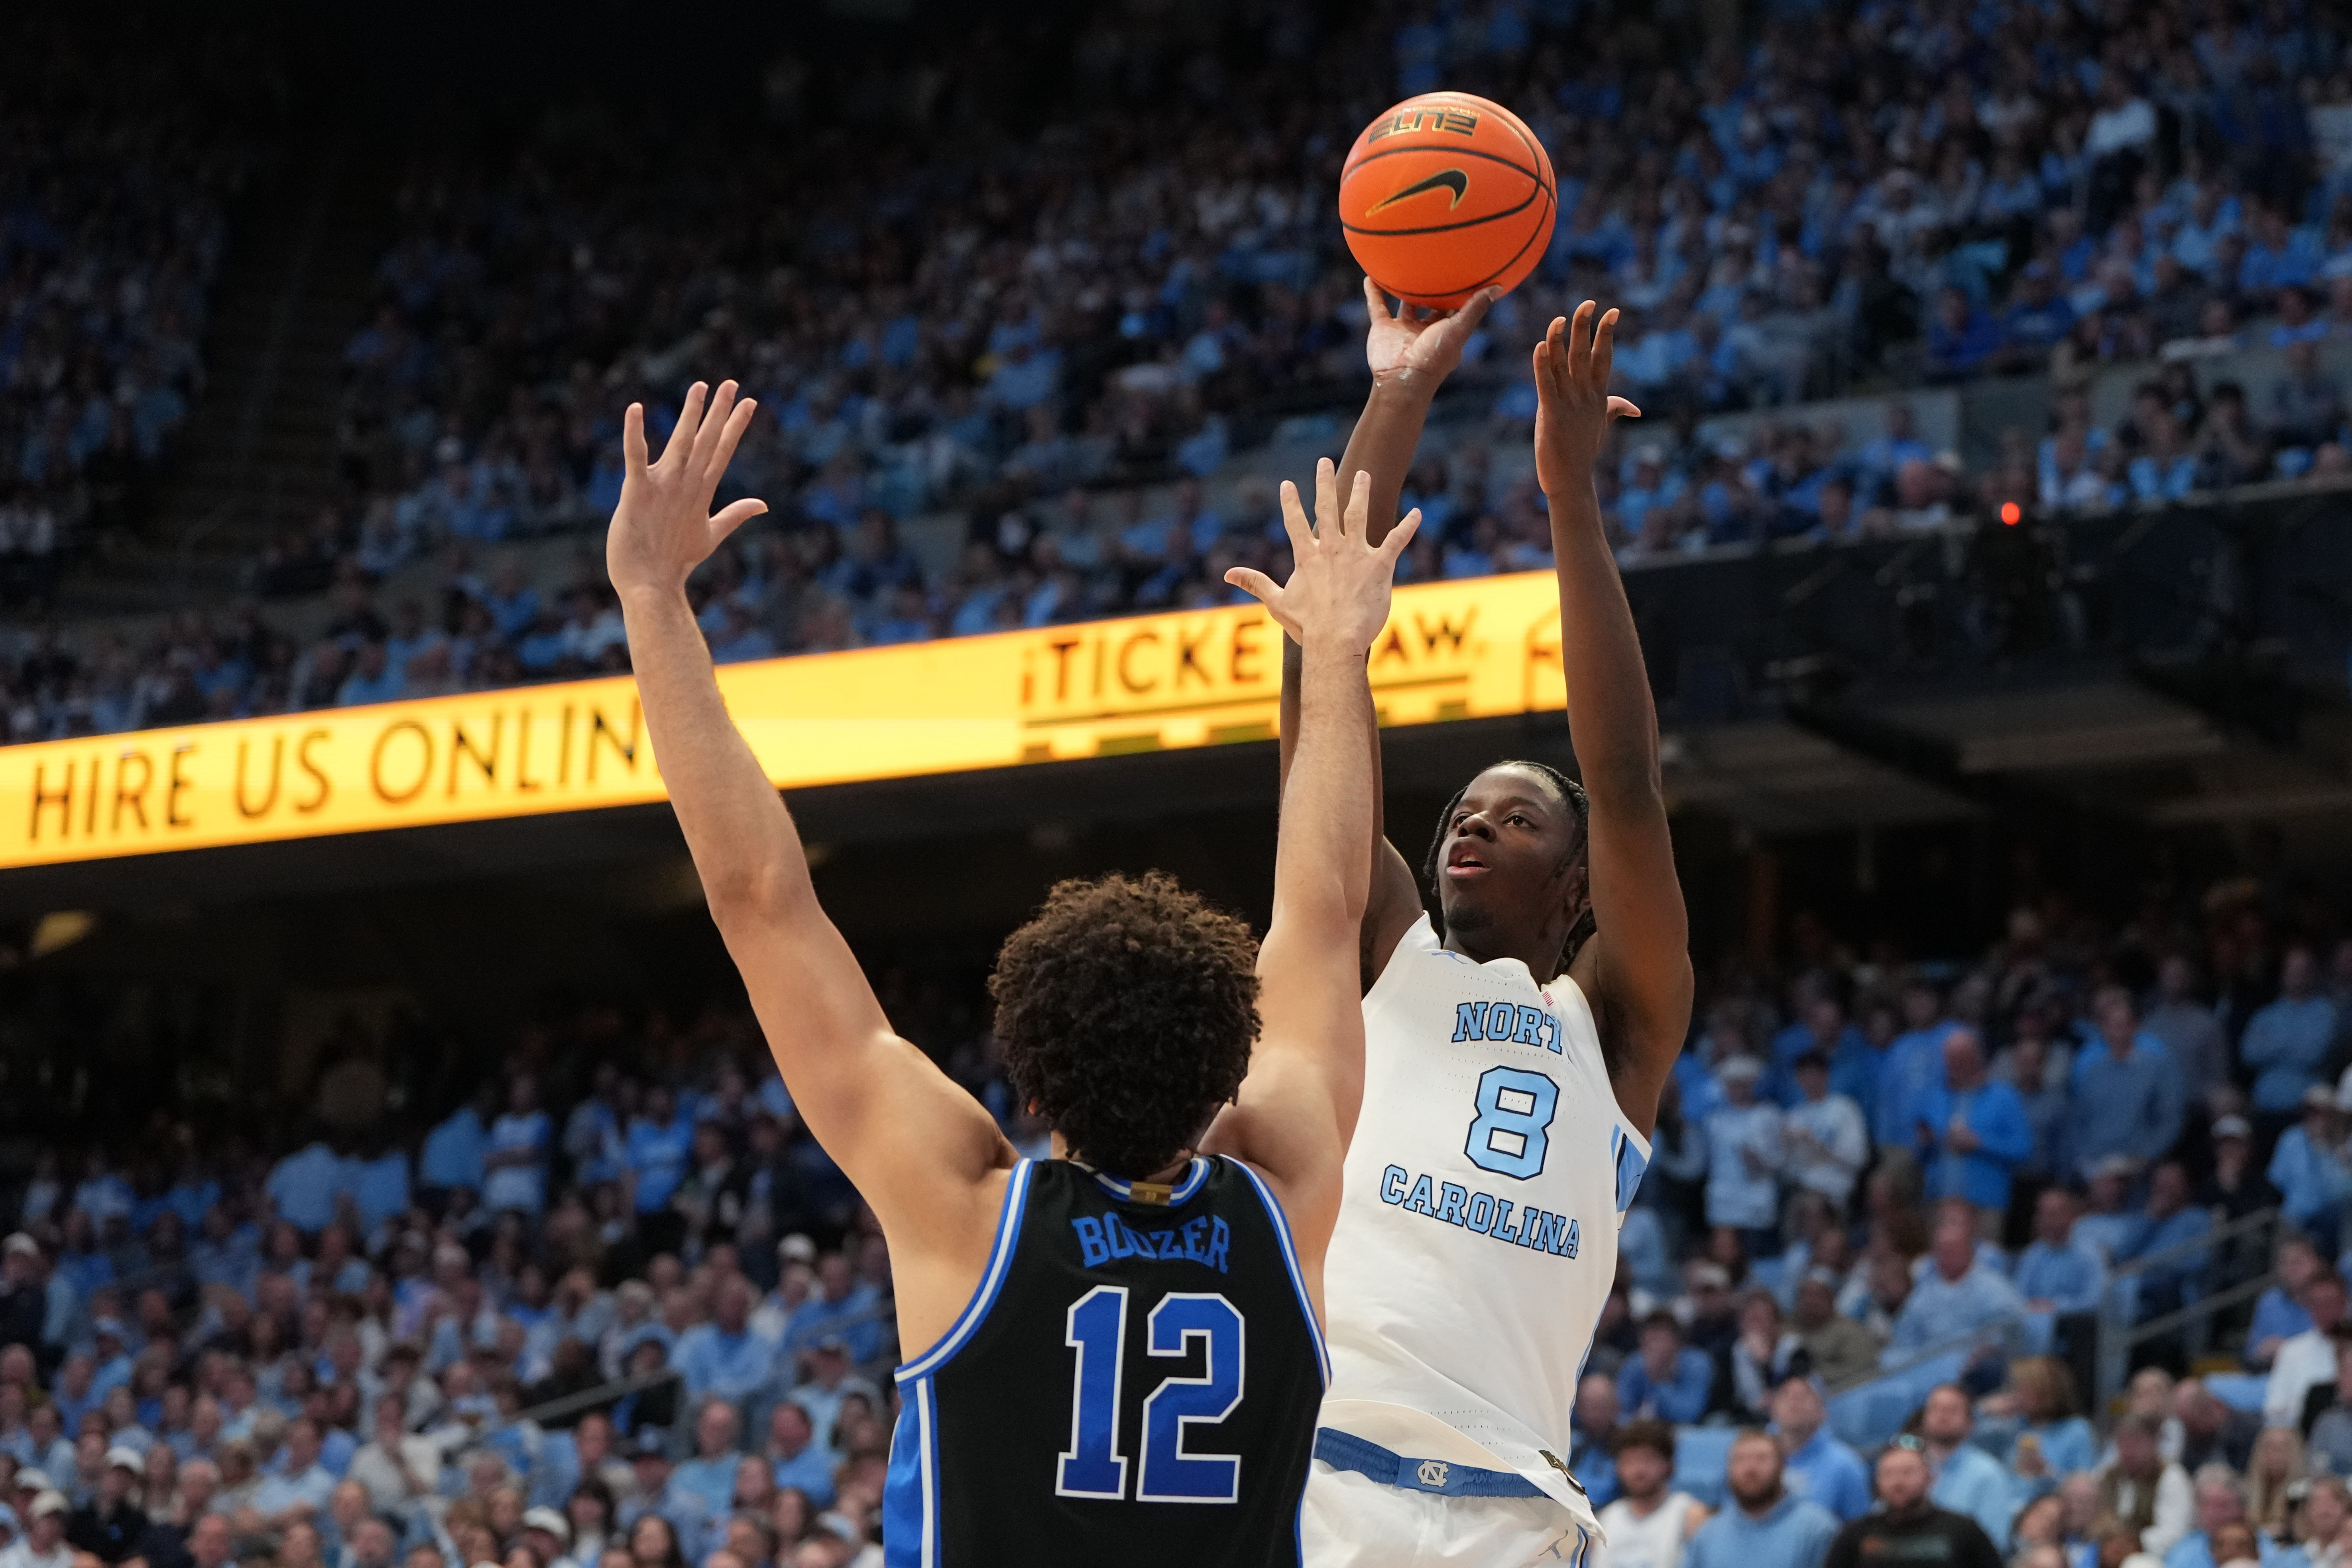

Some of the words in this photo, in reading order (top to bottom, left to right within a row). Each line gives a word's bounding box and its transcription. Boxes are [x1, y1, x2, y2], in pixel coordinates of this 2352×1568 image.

[1368, 111, 1477, 144] ELITE
[1021, 616, 1264, 705] iTICKE
[1371, 604, 1481, 672] AW
[28, 745, 199, 840] HIRE
[234, 729, 333, 819] US
[370, 696, 659, 805] ONLIN
[1451, 1002, 1562, 1055] NORT
[1463, 1065, 1560, 1181] 8
[1071, 1211, 1230, 1274] BOOZER
[1380, 1164, 1580, 1260] CAROLINA
[1055, 1285, 1245, 1503] 12
